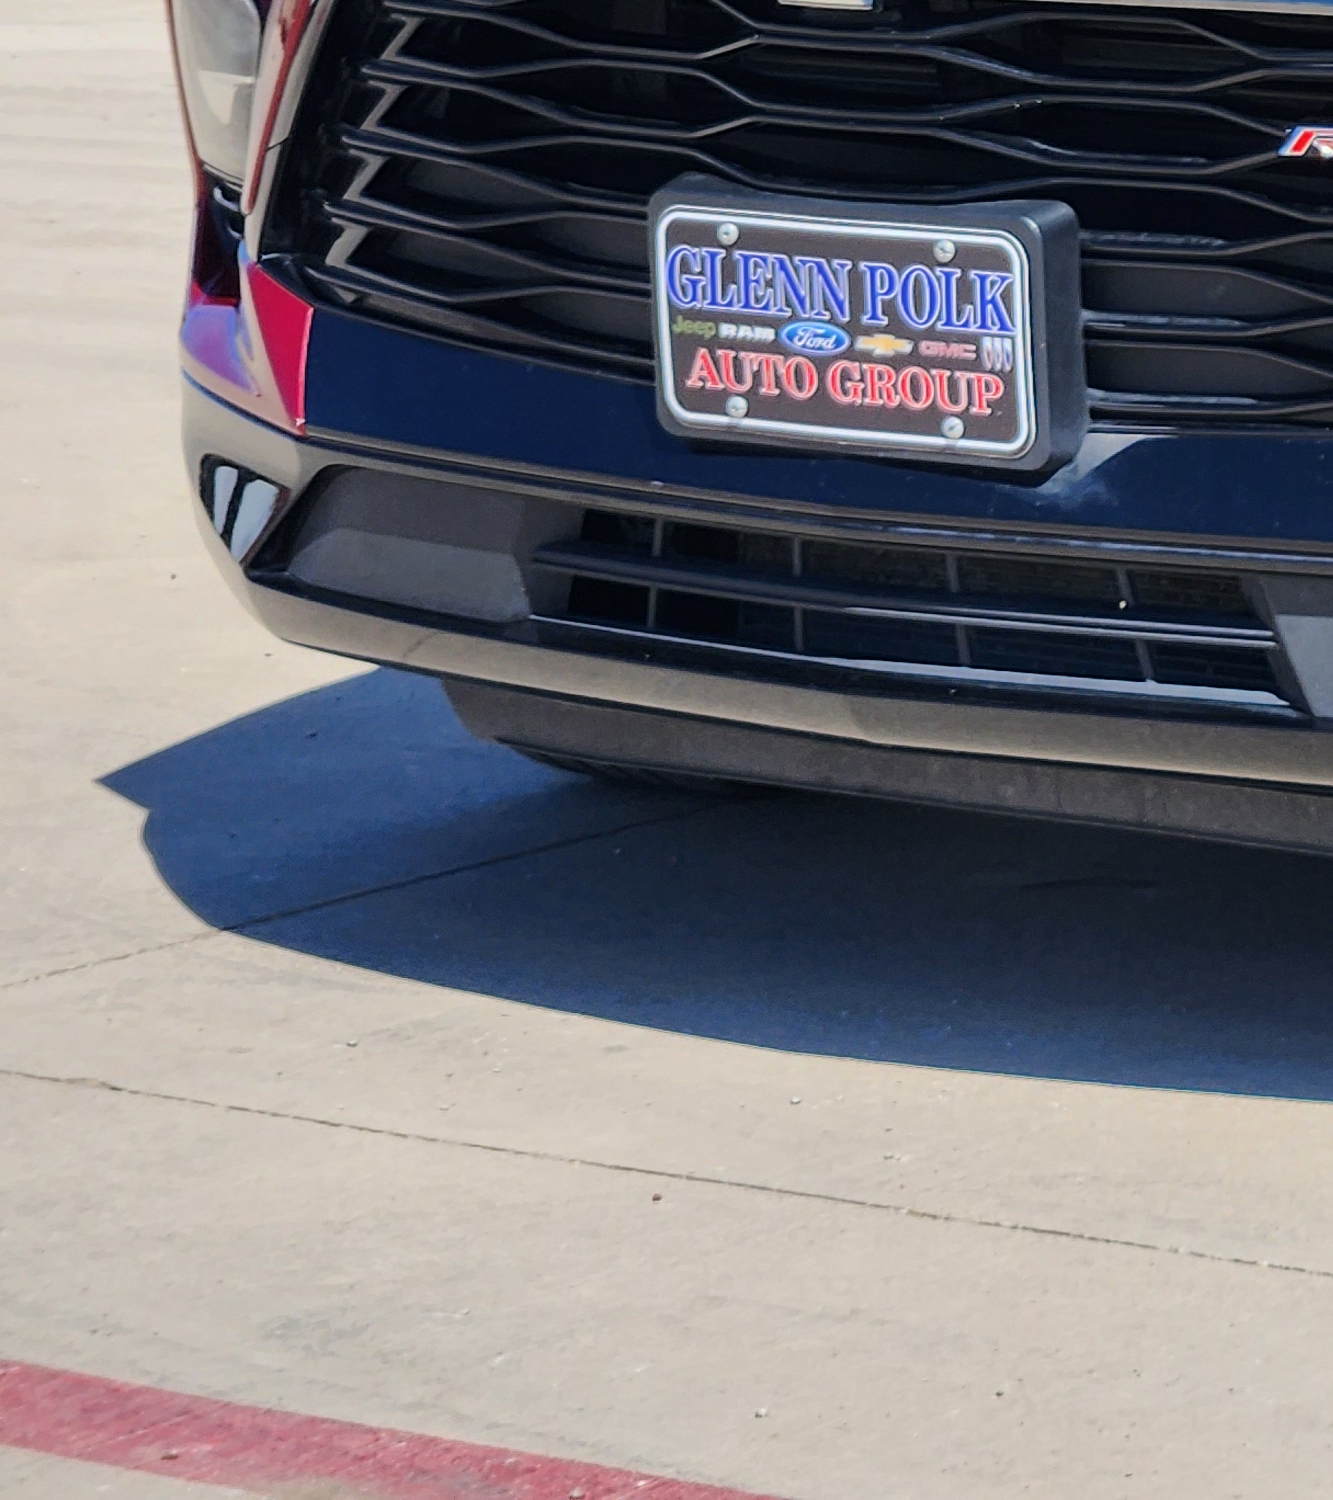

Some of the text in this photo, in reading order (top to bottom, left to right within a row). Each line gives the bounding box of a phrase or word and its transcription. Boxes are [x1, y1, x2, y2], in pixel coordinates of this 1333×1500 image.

[667, 244, 1017, 336] GLENN POLK
[671, 315, 717, 340] Jeep
[717, 322, 776, 342] RAM
[792, 326, 837, 352] Ford
[918, 339, 978, 361] GMC
[686, 348, 1006, 417] AUTO GROUP
